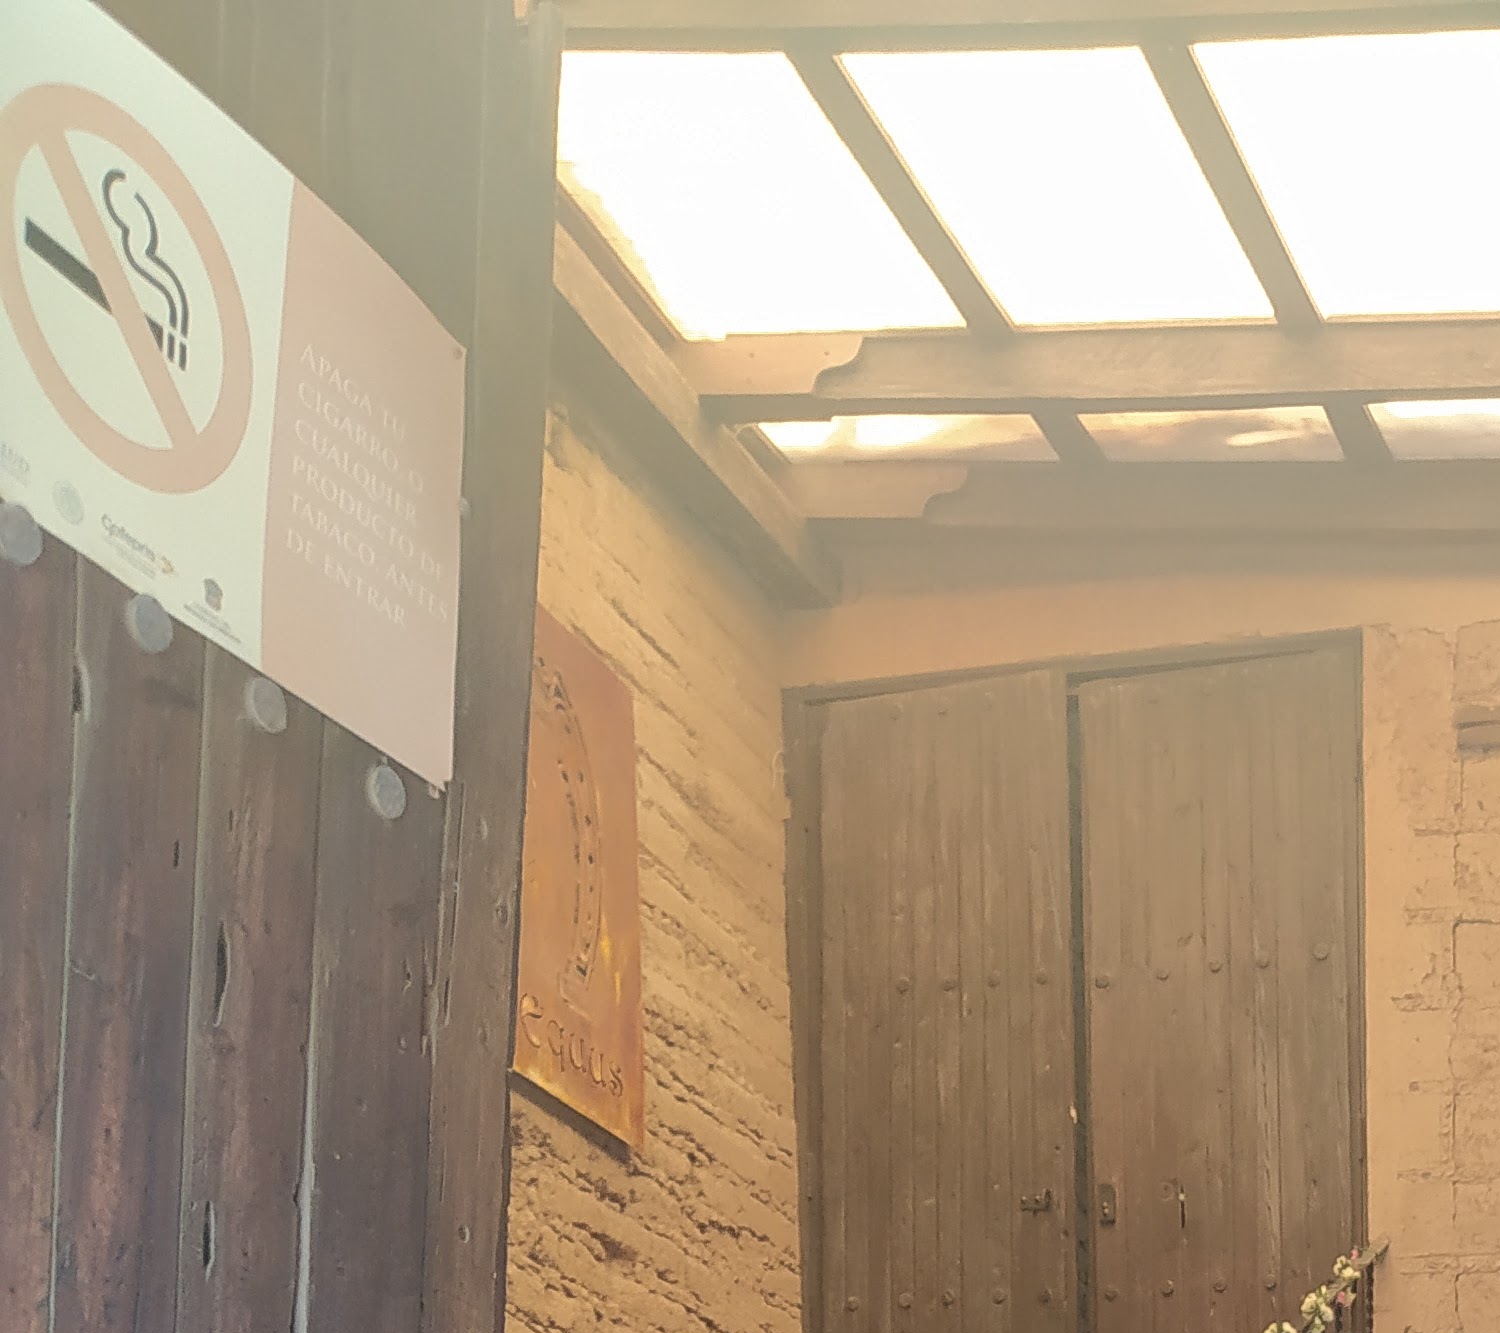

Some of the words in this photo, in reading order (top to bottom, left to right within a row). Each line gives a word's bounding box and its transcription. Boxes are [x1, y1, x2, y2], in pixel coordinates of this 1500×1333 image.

[300, 343, 372, 417] APAGA
[292, 454, 414, 558] PRODUCTO
[294, 418, 417, 527] CUALQUIER
[286, 527, 313, 566] DE
[322, 554, 407, 630] ENTRAR
